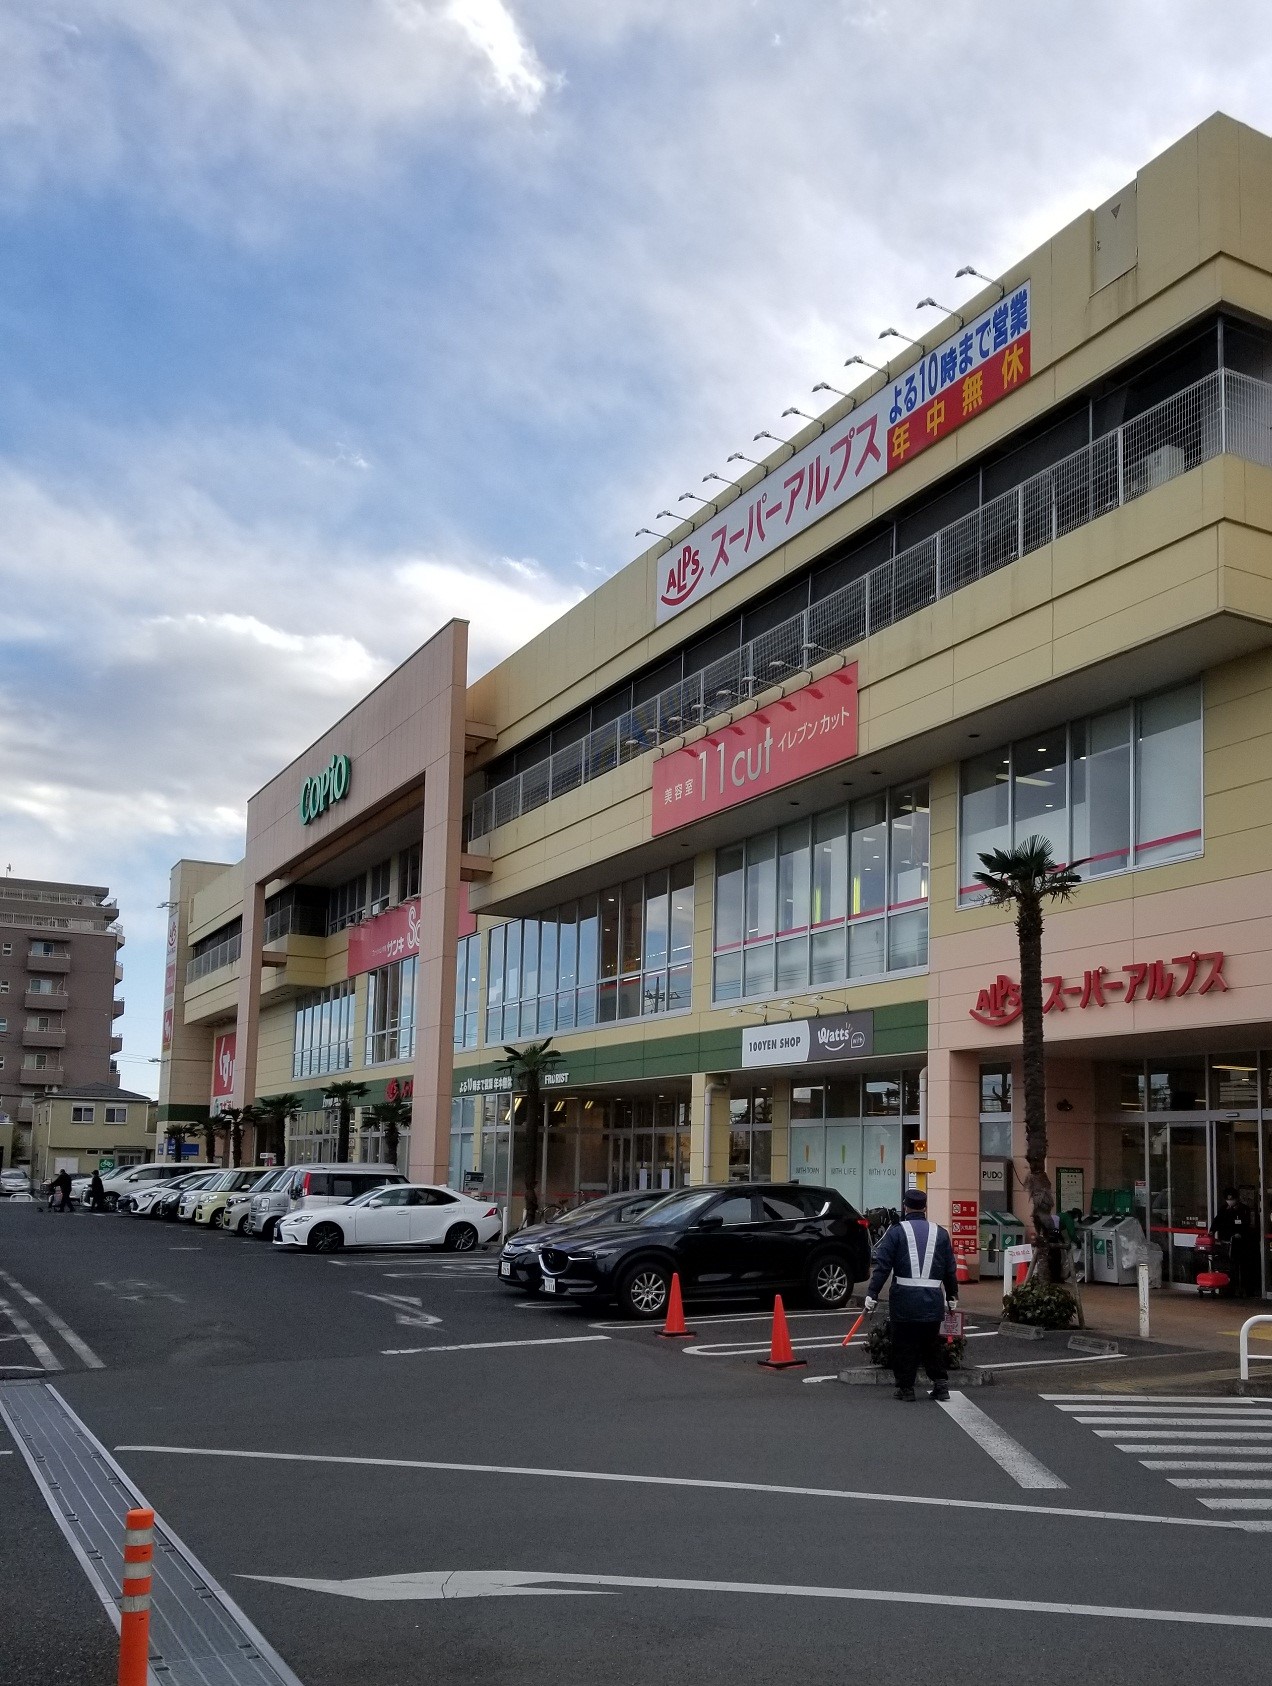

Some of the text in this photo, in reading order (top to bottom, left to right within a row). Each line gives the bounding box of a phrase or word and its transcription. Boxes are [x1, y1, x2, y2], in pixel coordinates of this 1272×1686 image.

[889, 288, 1028, 425] よる10時まで営業
[892, 342, 1024, 460] 年中無休
[665, 413, 882, 594] ALPS スーパーアルプス
[664, 778, 694, 805] 美容室
[777, 706, 850, 752] イレブンカット
[975, 951, 1229, 1018] ALPS スーパーアルプス
[749, 1036, 801, 1052] 100YEN SHOP
[817, 1027, 850, 1044] Watts
[882, 1168, 897, 1176] YOU
[982, 1170, 1003, 1179] PUDO
